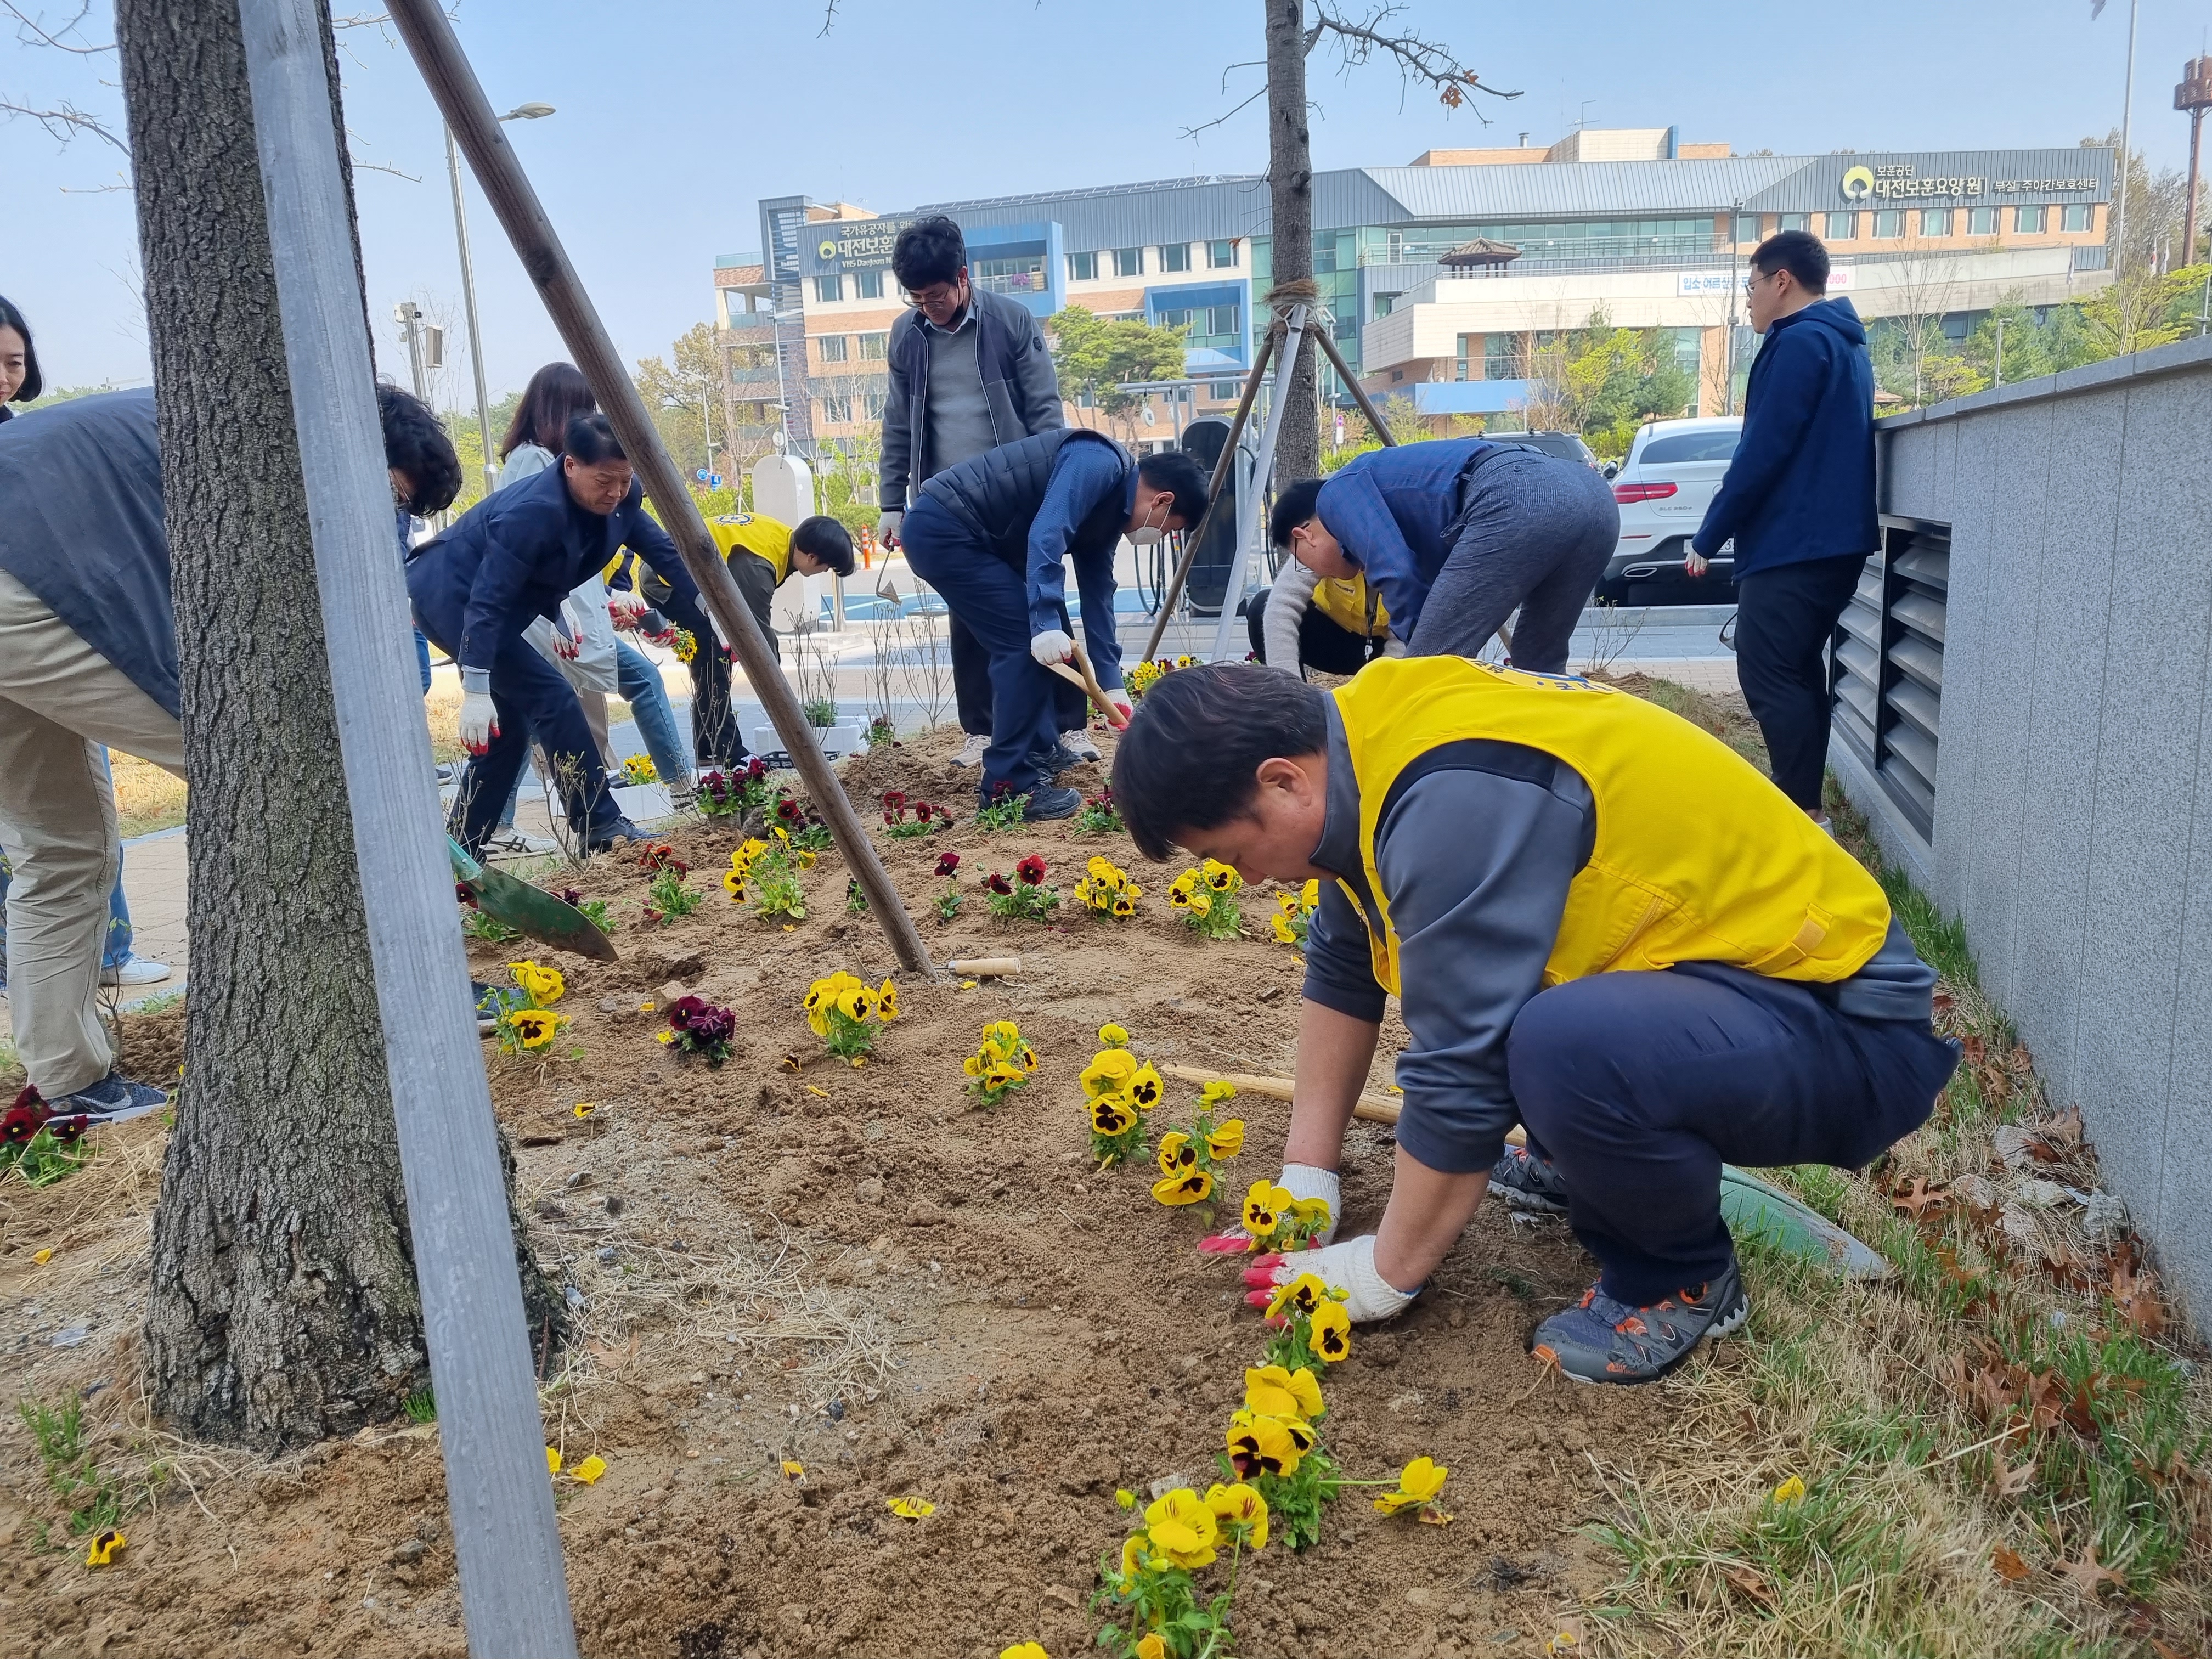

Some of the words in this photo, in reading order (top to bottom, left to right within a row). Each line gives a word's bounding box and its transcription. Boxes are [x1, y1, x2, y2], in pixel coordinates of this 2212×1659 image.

[1877, 165, 1915, 177] 보훈공단
[1875, 177, 1981, 198] 대전보훈요양원
[1994, 180, 2016, 192] 부설
[2022, 178, 2099, 191] 주야간보호센터
[840, 222, 896, 238] 국가유공자를
[838, 235, 898, 258] 대전보훈
[842, 259, 856, 268] VHS
[1683, 277, 1701, 290] 입소
